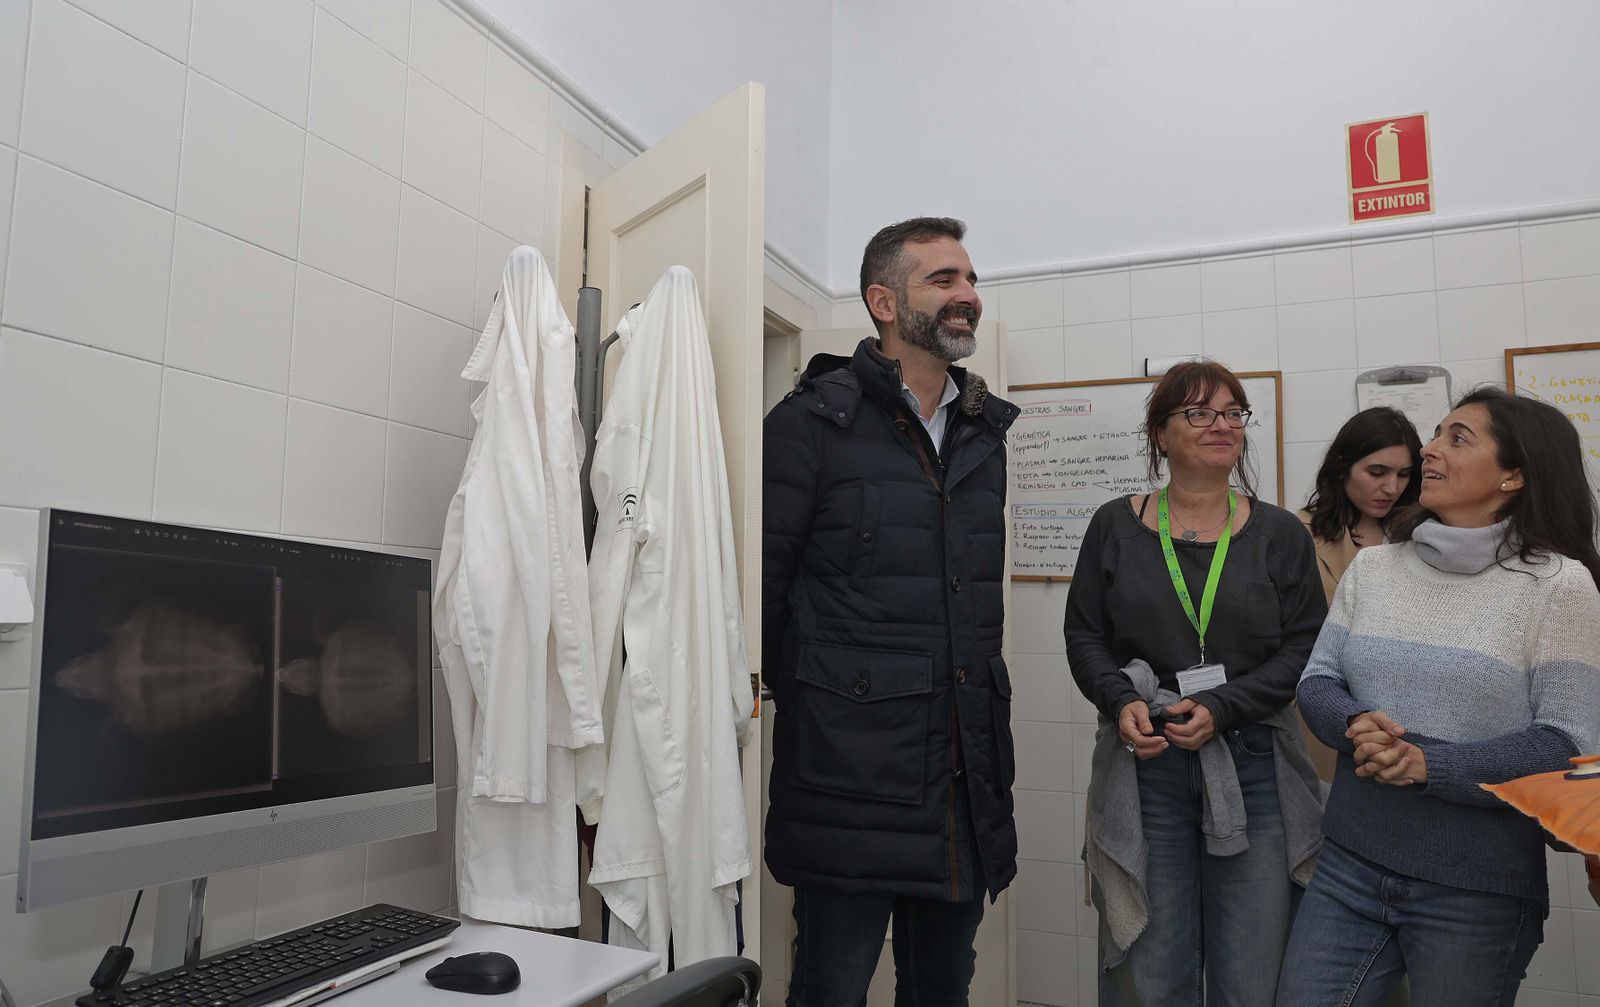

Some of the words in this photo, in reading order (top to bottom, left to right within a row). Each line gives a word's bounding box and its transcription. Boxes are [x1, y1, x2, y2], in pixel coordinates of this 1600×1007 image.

[1358, 192, 1425, 212] EXTINTOR
[1549, 376, 1600, 387] GENETI
[1059, 404, 1087, 413] SANGRE
[1567, 412, 1590, 423] DTA
[1061, 434, 1088, 443] SANGRE
[1016, 459, 1046, 468] PLASMA
[1060, 457, 1092, 466] SANGRE
[1095, 454, 1130, 462] HEPARINA
[1017, 472, 1039, 480] EDTA
[1054, 468, 1109, 478] CONGELADOR
[1113, 486, 1143, 494] PLASMA
[1015, 505, 1057, 517] ESTUDIO
[1022, 523, 1037, 531] Foto
[1040, 524, 1064, 534] tortuga
[1023, 541, 1048, 553] Recoger
